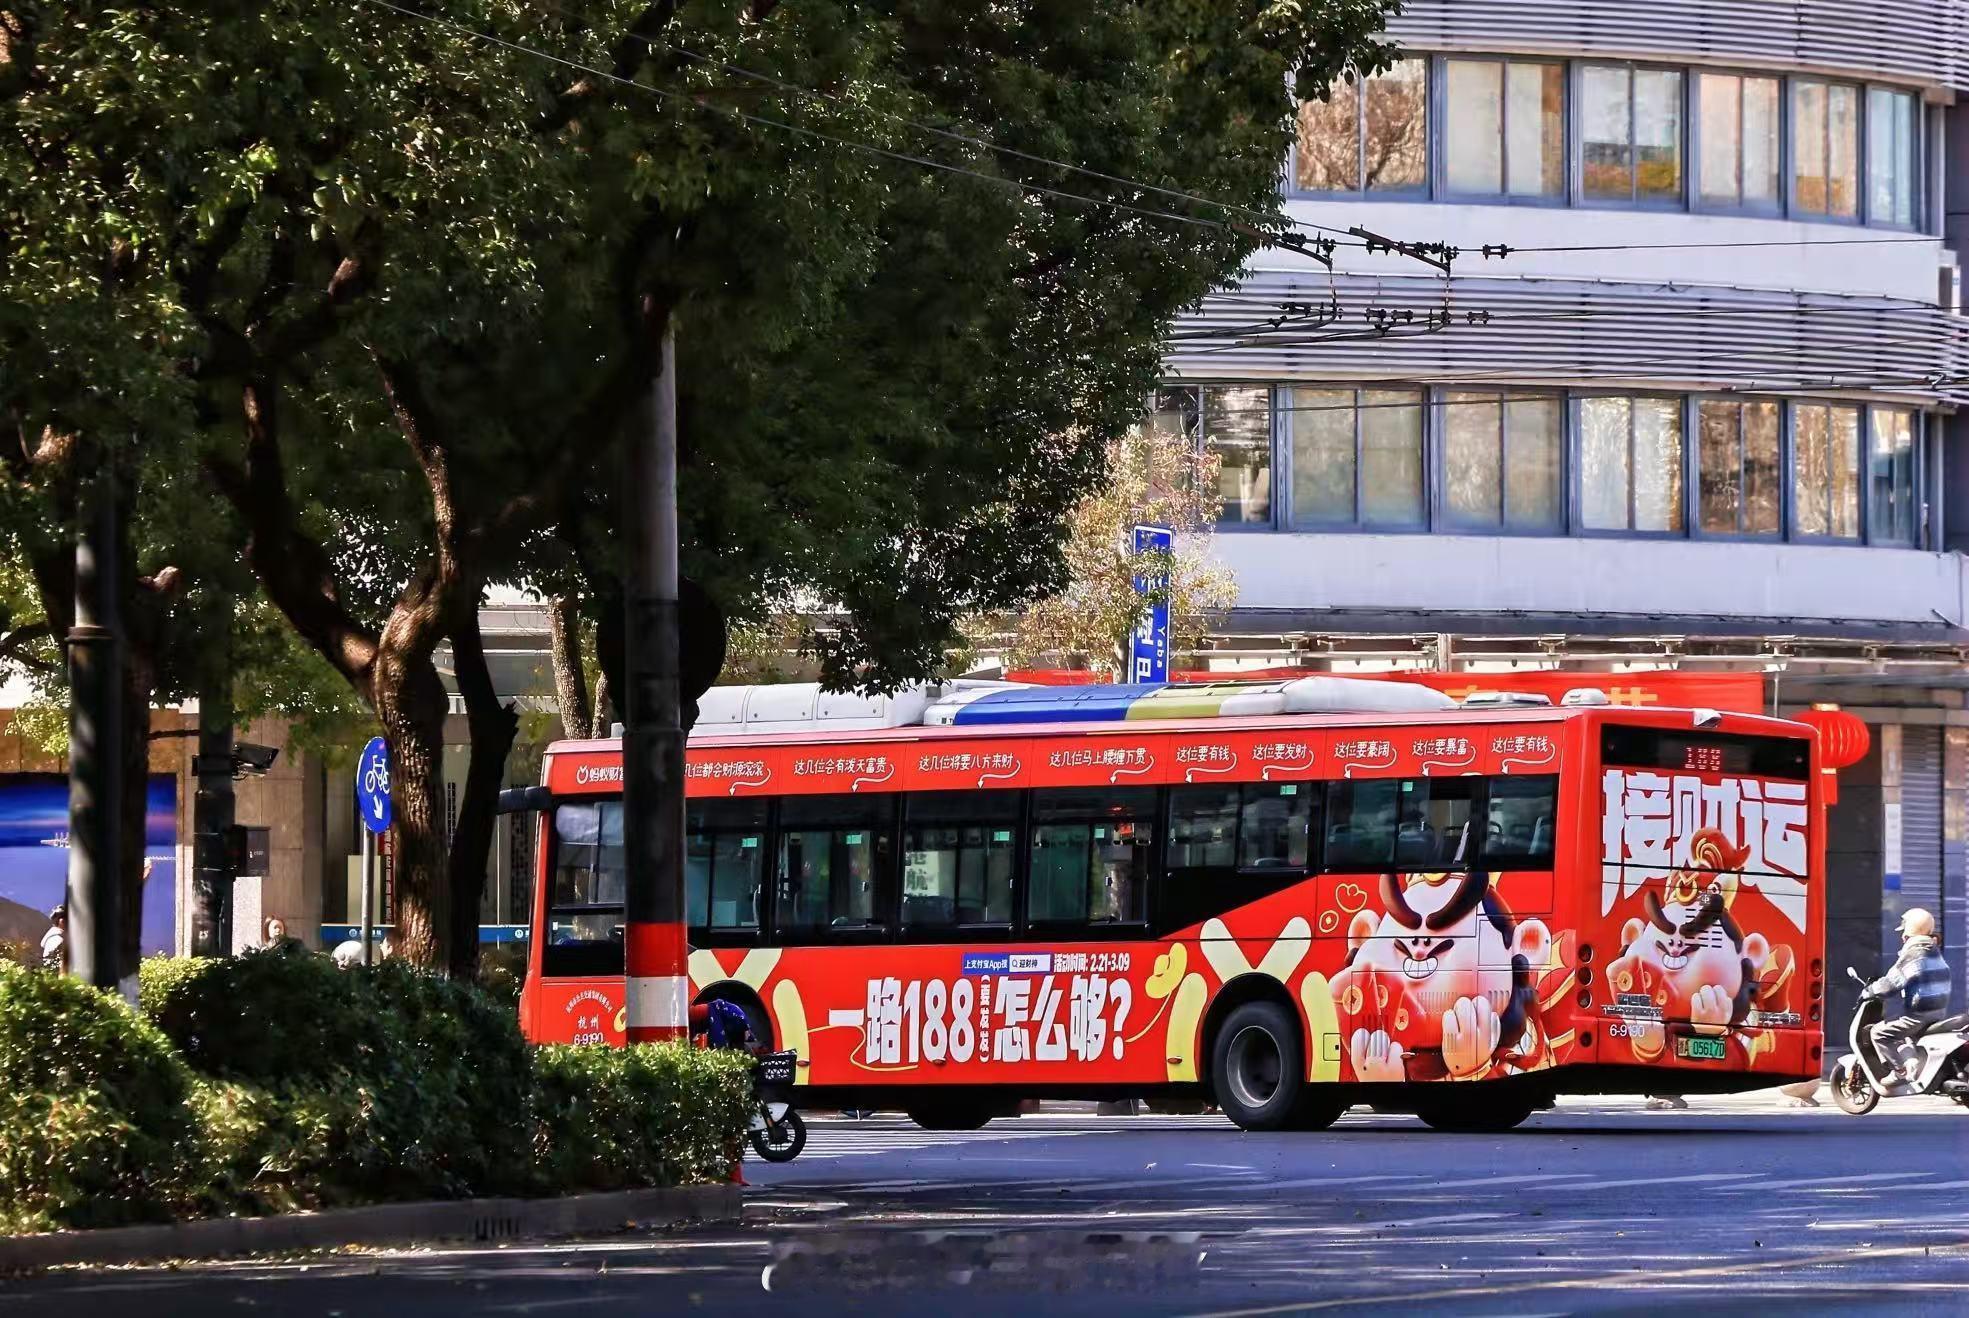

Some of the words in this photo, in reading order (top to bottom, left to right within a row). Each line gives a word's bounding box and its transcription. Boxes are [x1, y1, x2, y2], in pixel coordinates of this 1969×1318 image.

[1176, 745, 1231, 762] 这位要有钱
[1252, 743, 1308, 761] 这位要发财
[1333, 740, 1391, 759] 这位要豪阔
[1411, 737, 1469, 756] 这位要暴富
[1491, 735, 1549, 753] 这位要有钱
[793, 756, 888, 776] 这几位会有泼天富贵
[918, 752, 1014, 772] 这几位将要八方来财
[1049, 747, 1147, 768] 这几位马上腰缠万贯
[1684, 747, 1721, 771] 188
[1602, 769, 1808, 935] 接财运
[1019, 958, 1039, 969] 迎财神
[1089, 952, 1131, 973] 2.21-3.09
[577, 1013, 600, 1030] 杭州
